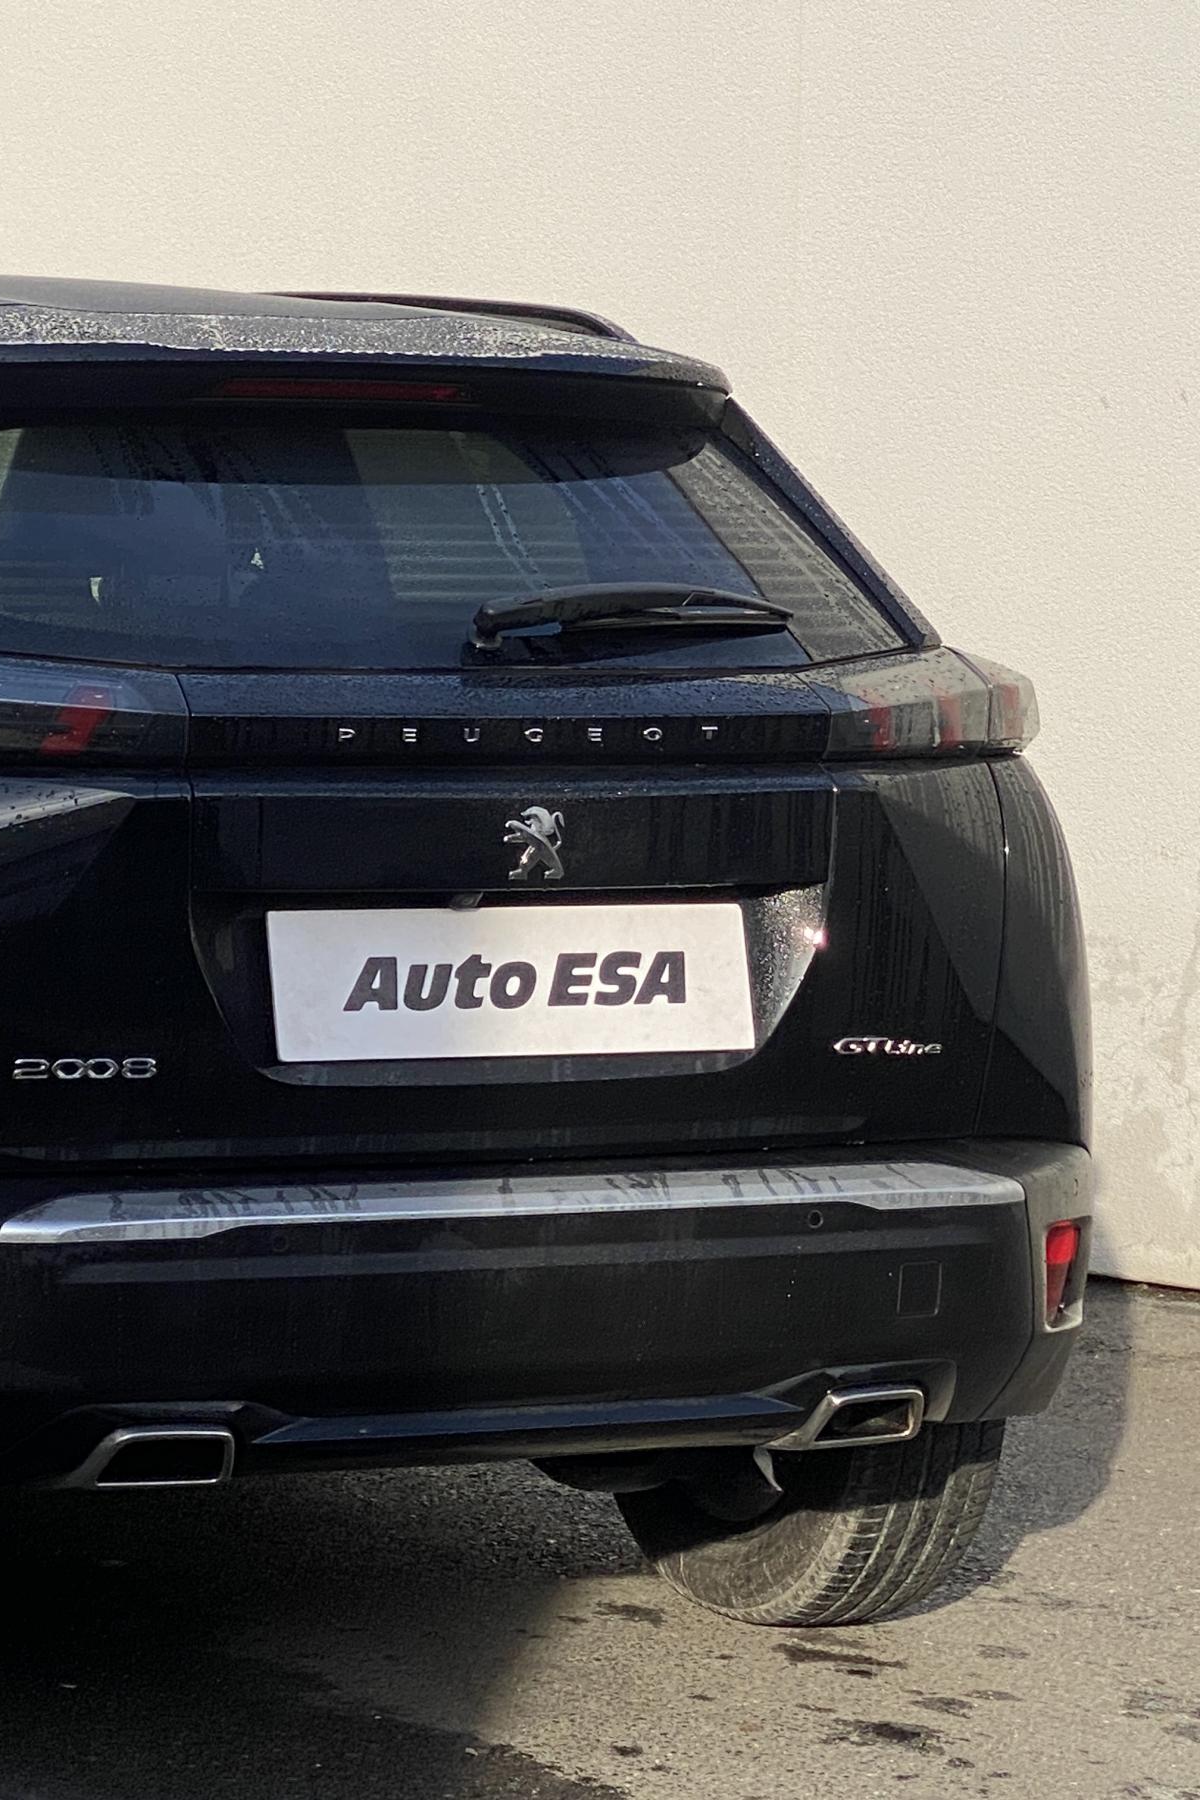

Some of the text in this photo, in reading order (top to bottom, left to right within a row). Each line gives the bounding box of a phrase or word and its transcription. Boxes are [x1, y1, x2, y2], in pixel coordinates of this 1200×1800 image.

[338, 725, 719, 743] PEUGEOT
[342, 950, 687, 1012] Auto ESA
[11, 1057, 158, 1080] 2008
